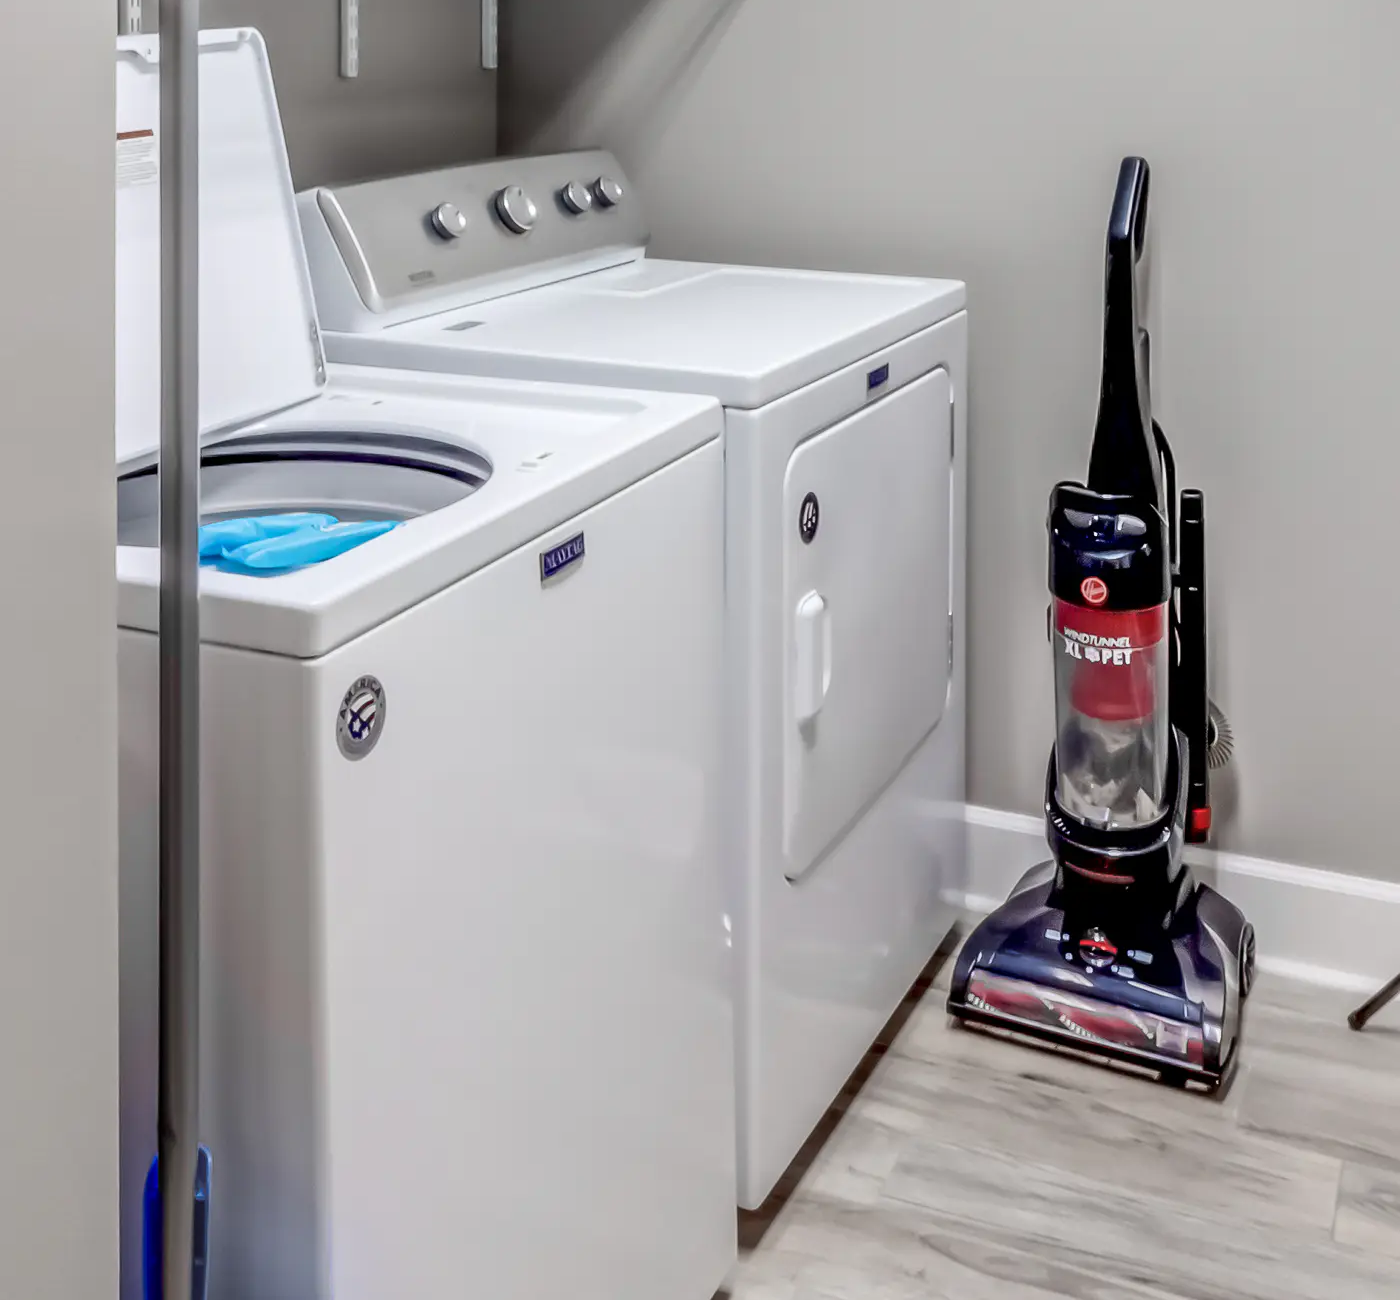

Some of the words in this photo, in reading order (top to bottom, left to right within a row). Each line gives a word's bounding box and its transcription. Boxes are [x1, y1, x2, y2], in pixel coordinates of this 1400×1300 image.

[545, 539, 583, 569] MAYTAG
[1064, 626, 1131, 647] WINDTUNNEL
[1065, 638, 1082, 659] XL
[1102, 649, 1132, 666] PET
